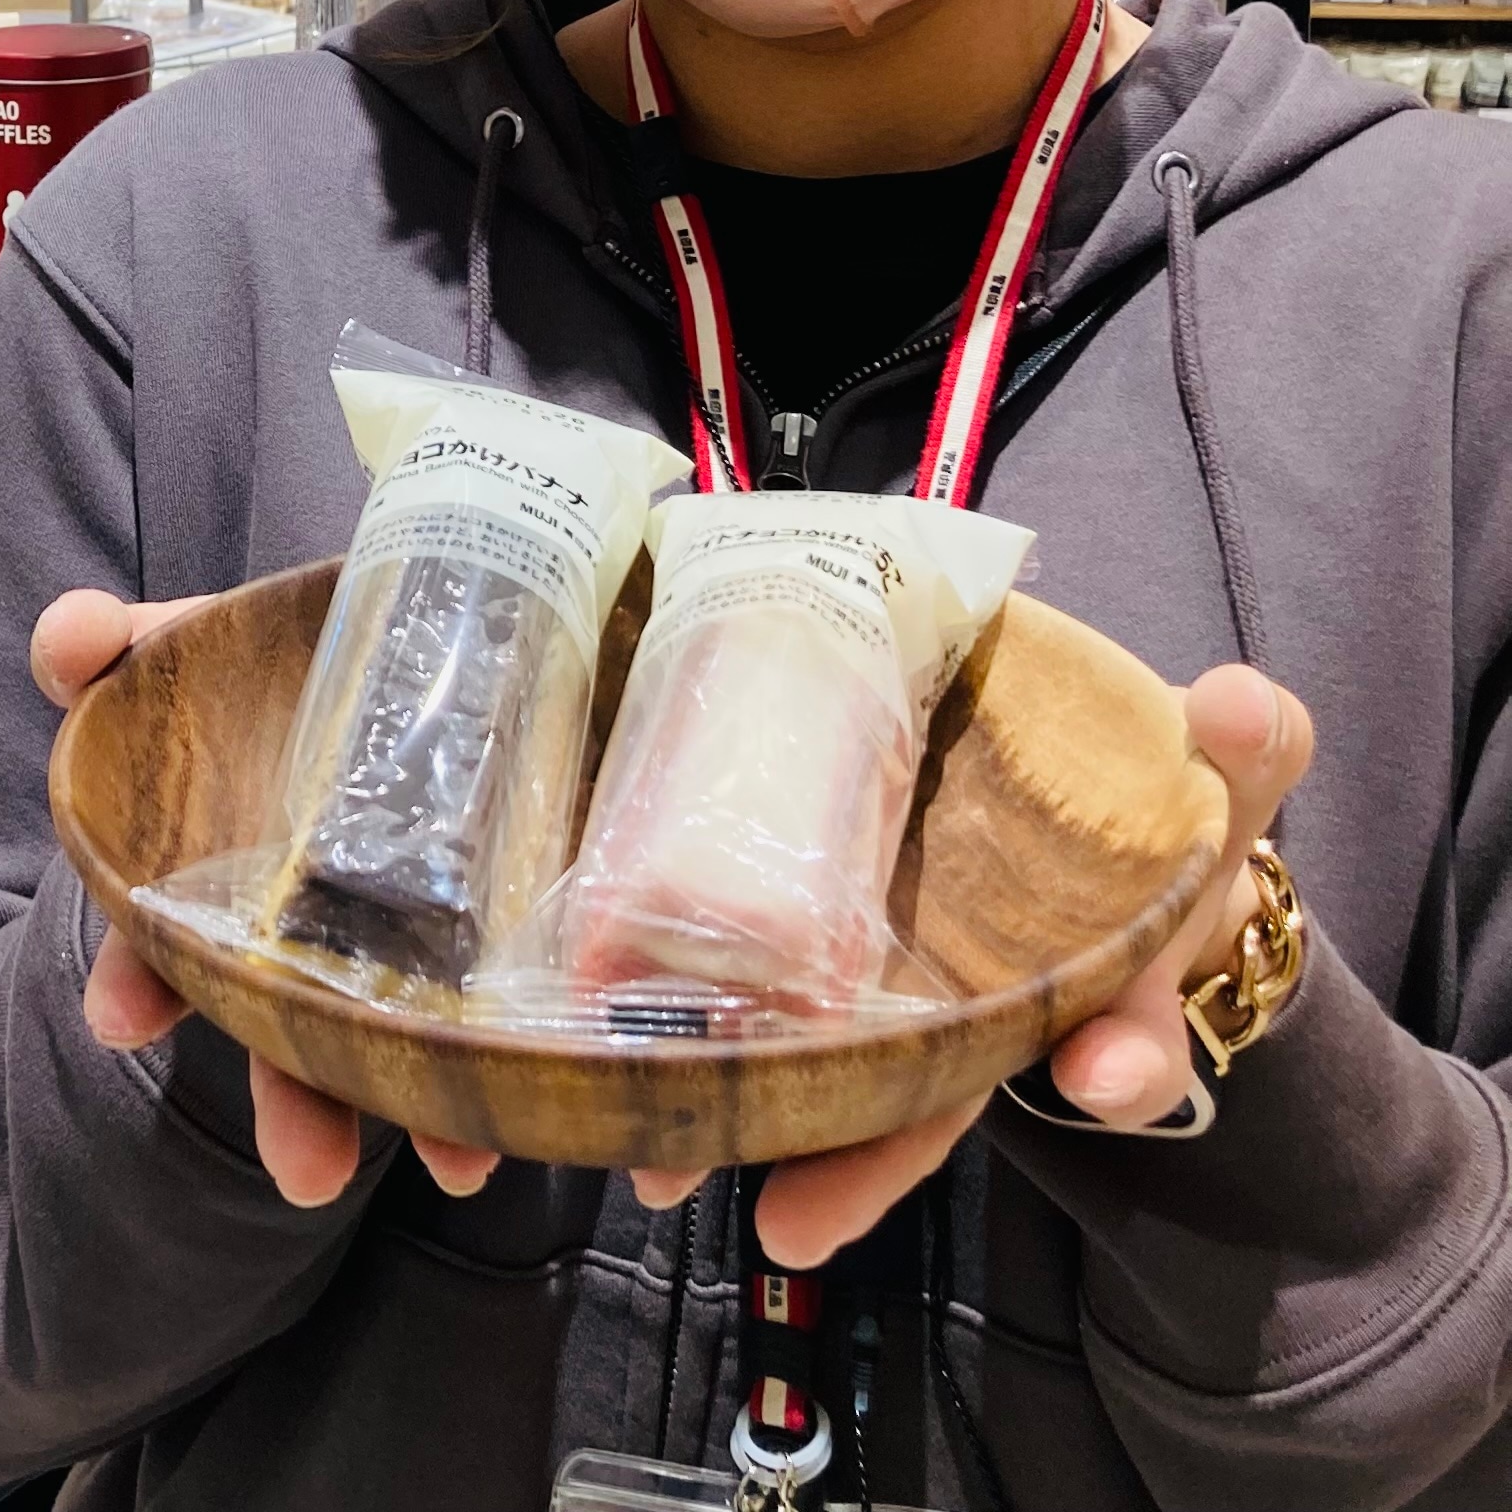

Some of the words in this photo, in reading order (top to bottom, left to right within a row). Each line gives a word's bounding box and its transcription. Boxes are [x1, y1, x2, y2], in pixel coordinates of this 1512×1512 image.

[425, 459, 514, 485] Baumkuchen
[520, 482, 548, 500] with
[520, 501, 558, 529] MUJI
[806, 552, 848, 581] MUJI
